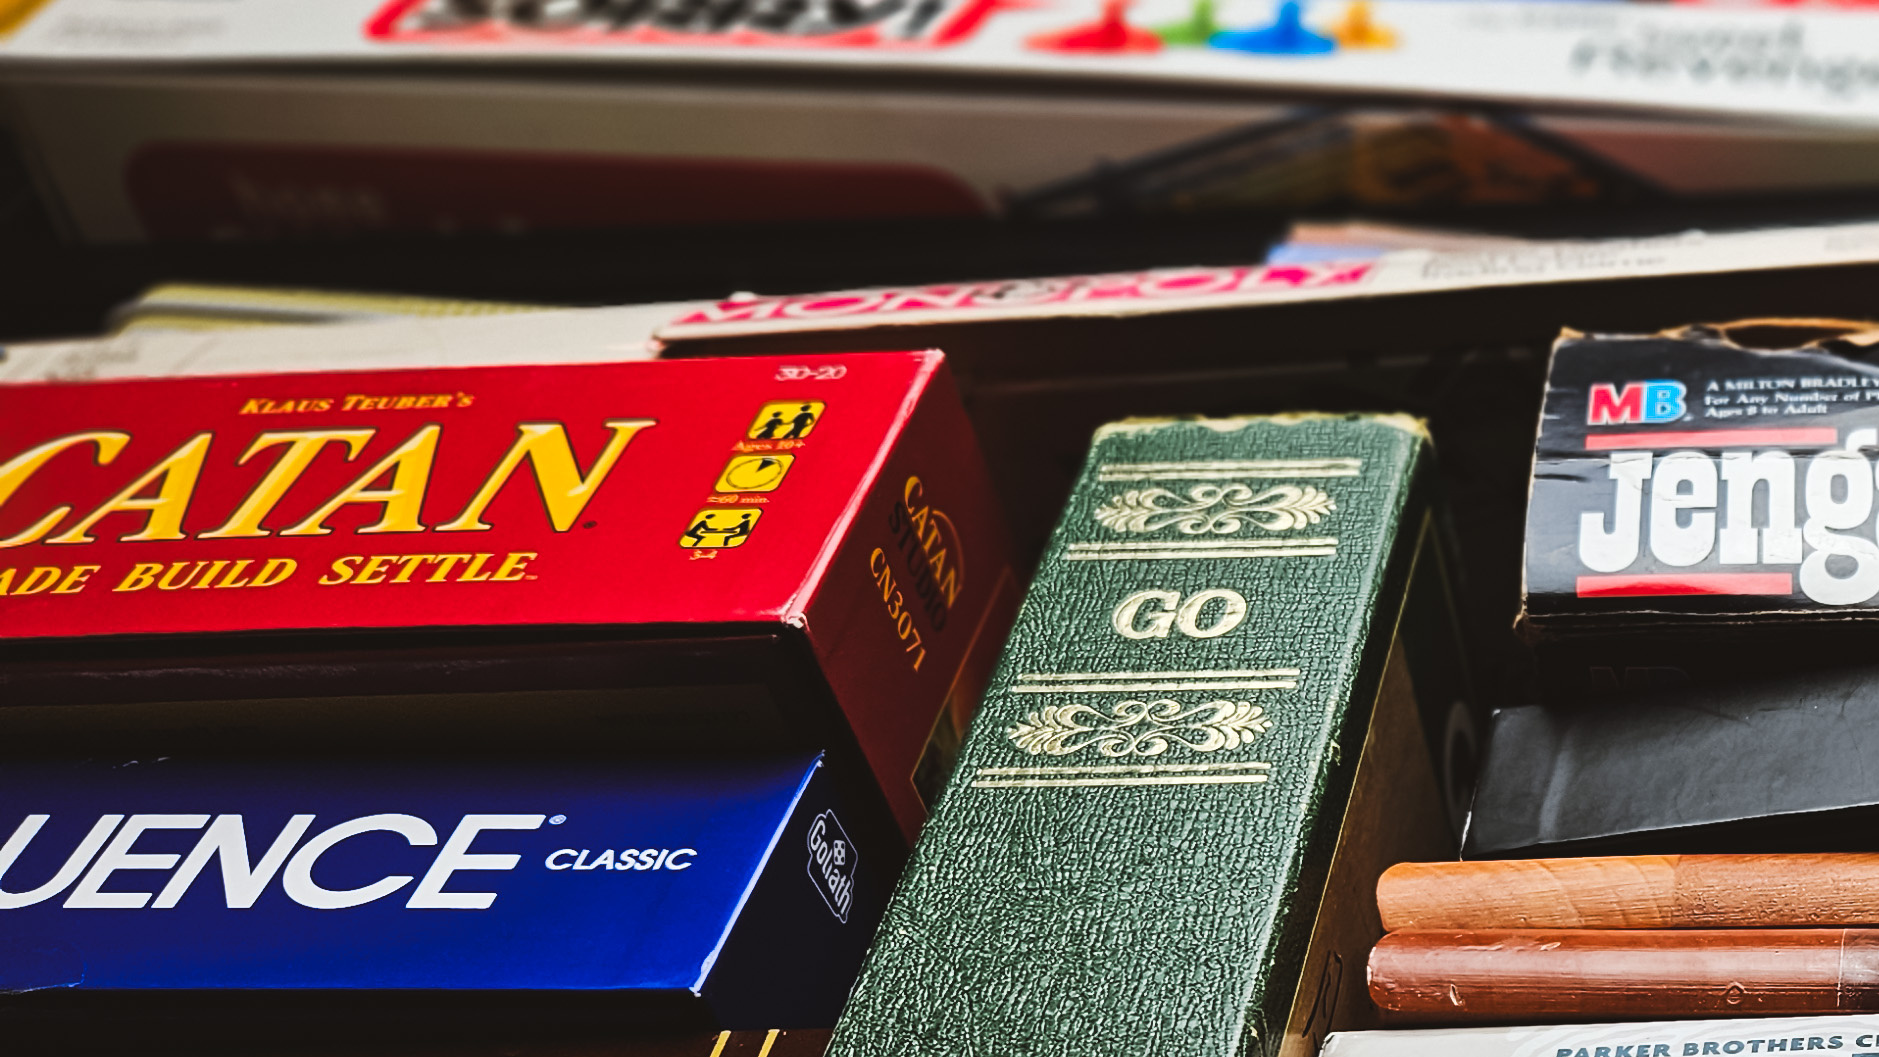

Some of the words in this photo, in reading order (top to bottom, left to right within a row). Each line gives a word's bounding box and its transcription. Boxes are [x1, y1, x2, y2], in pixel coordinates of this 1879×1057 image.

[239, 397, 333, 415] KLAUS
[1588, 379, 1687, 424] MB
[1705, 395, 1729, 405] For
[1736, 393, 1768, 405] Any
[1775, 391, 1838, 403] Number
[1843, 391, 1860, 401] of
[1707, 381, 1719, 391] A
[1725, 378, 1796, 390] MILTON
[1705, 406, 1742, 418] Ages
[1762, 405, 1778, 415] to
[1784, 403, 1828, 415] Adult
[0, 417, 659, 549] CATAN
[905, 476, 962, 609] CATAN
[112, 557, 299, 592] BUILD
[871, 547, 927, 673] CN3071
[1112, 588, 1248, 640] GO
[0, 813, 547, 910] UENCE
[544, 848, 698, 872] CLASSIC
[811, 820, 851, 914] Goliath
[1682, 1036, 1844, 1057] BROTHERS
